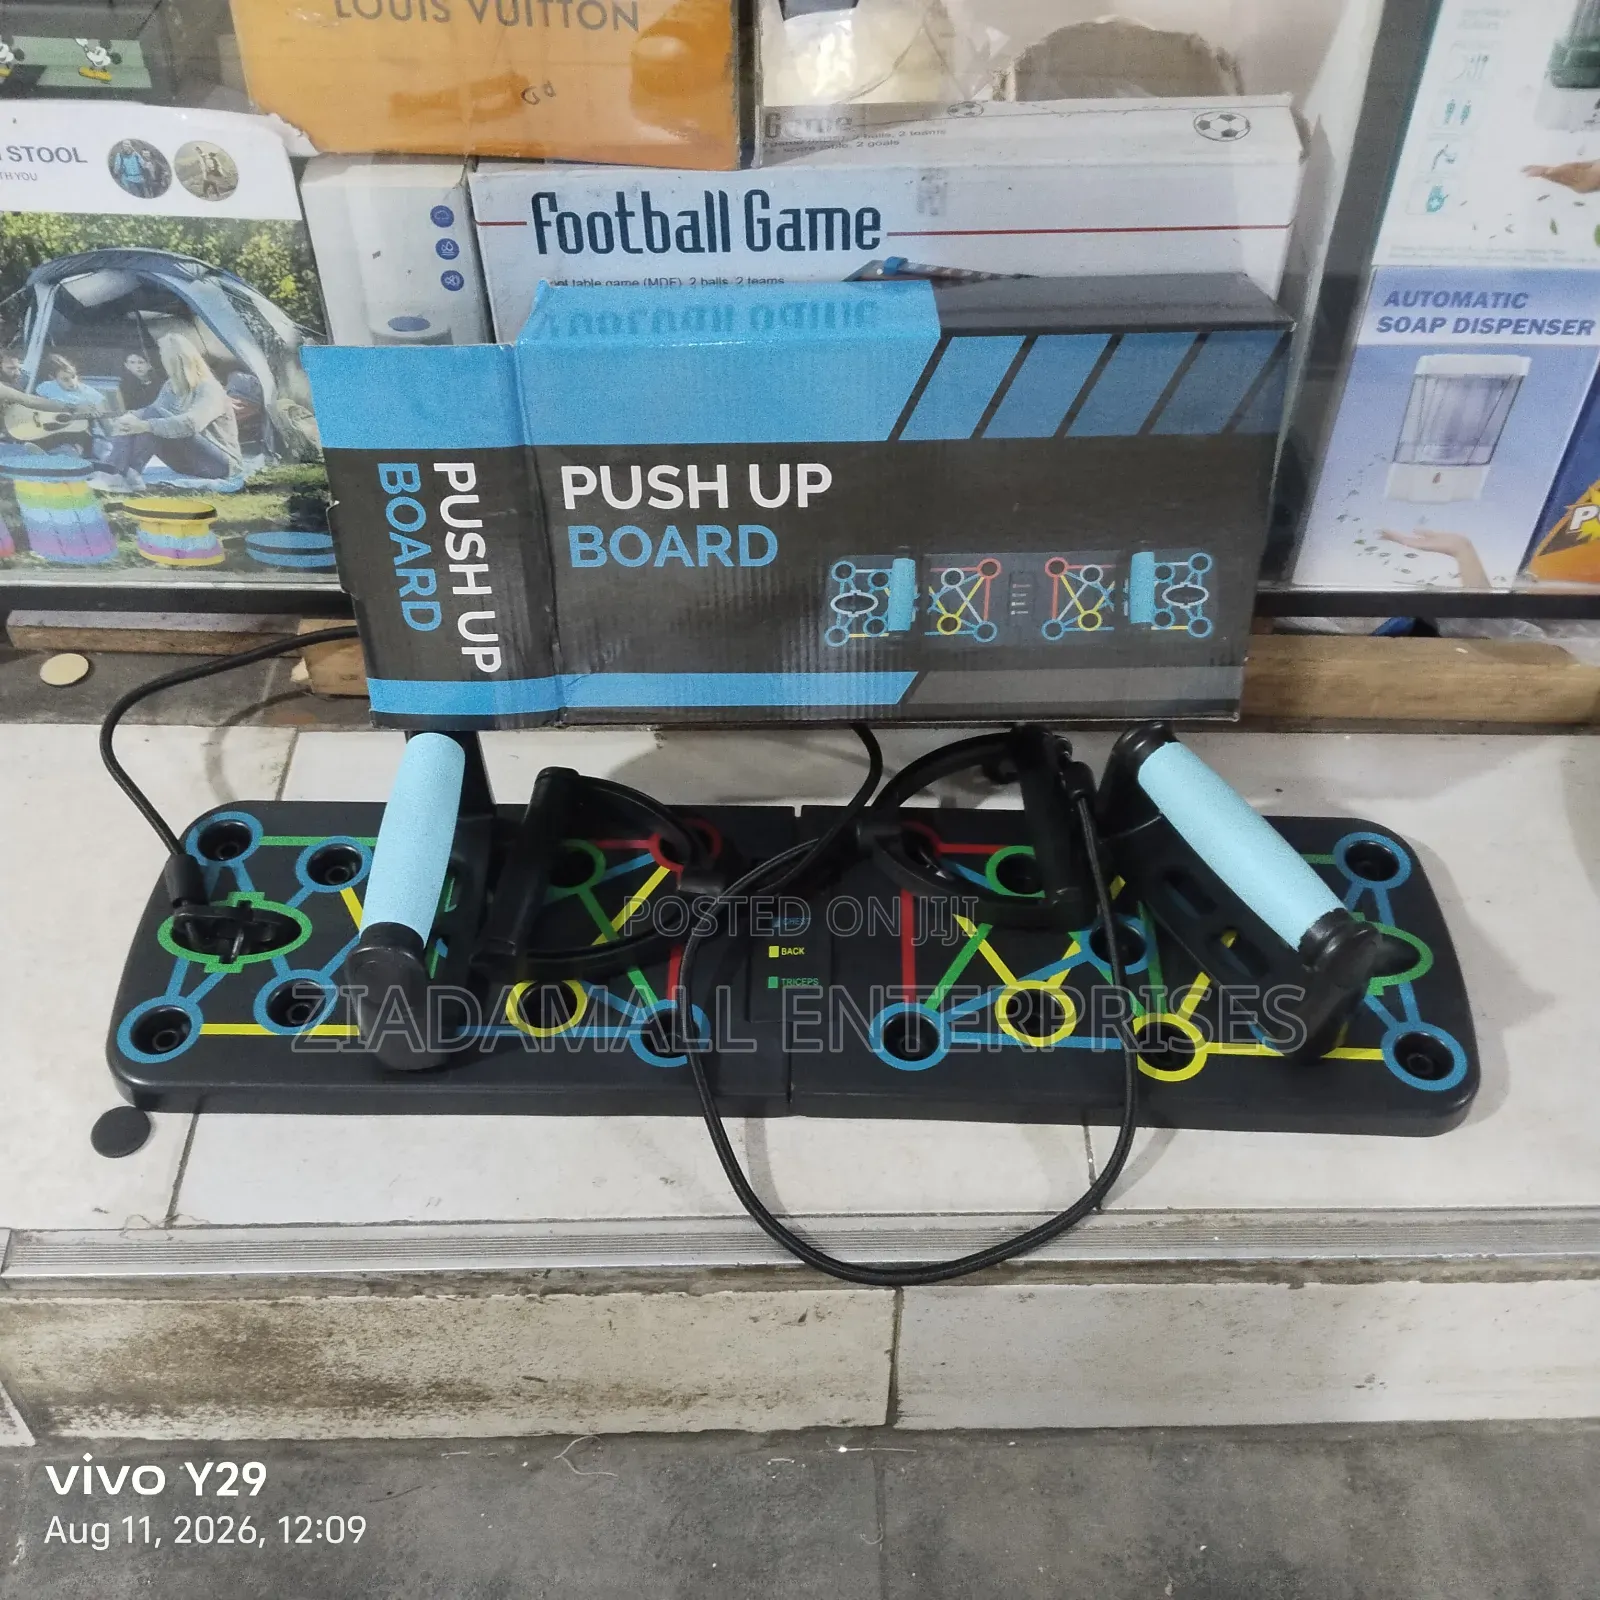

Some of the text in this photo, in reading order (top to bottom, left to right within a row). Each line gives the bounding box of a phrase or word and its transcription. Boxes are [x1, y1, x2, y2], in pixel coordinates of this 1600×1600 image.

[336, 0, 640, 32] LOUIS VUITTON
[867, 139, 901, 148] goals
[6, 145, 88, 163] STOOL
[14, 171, 38, 181] YOU
[744, 189, 881, 252] Game
[1384, 290, 1530, 309] AUTOMATIC
[1376, 316, 1596, 336] SOAP DISPENSER
[561, 463, 833, 510] PUSH UP
[377, 463, 442, 632] BOARD
[568, 524, 778, 569] BOARD
[433, 463, 501, 673] PUSH UP
[781, 947, 805, 956] BACK
[781, 978, 819, 986] TRICEPS
